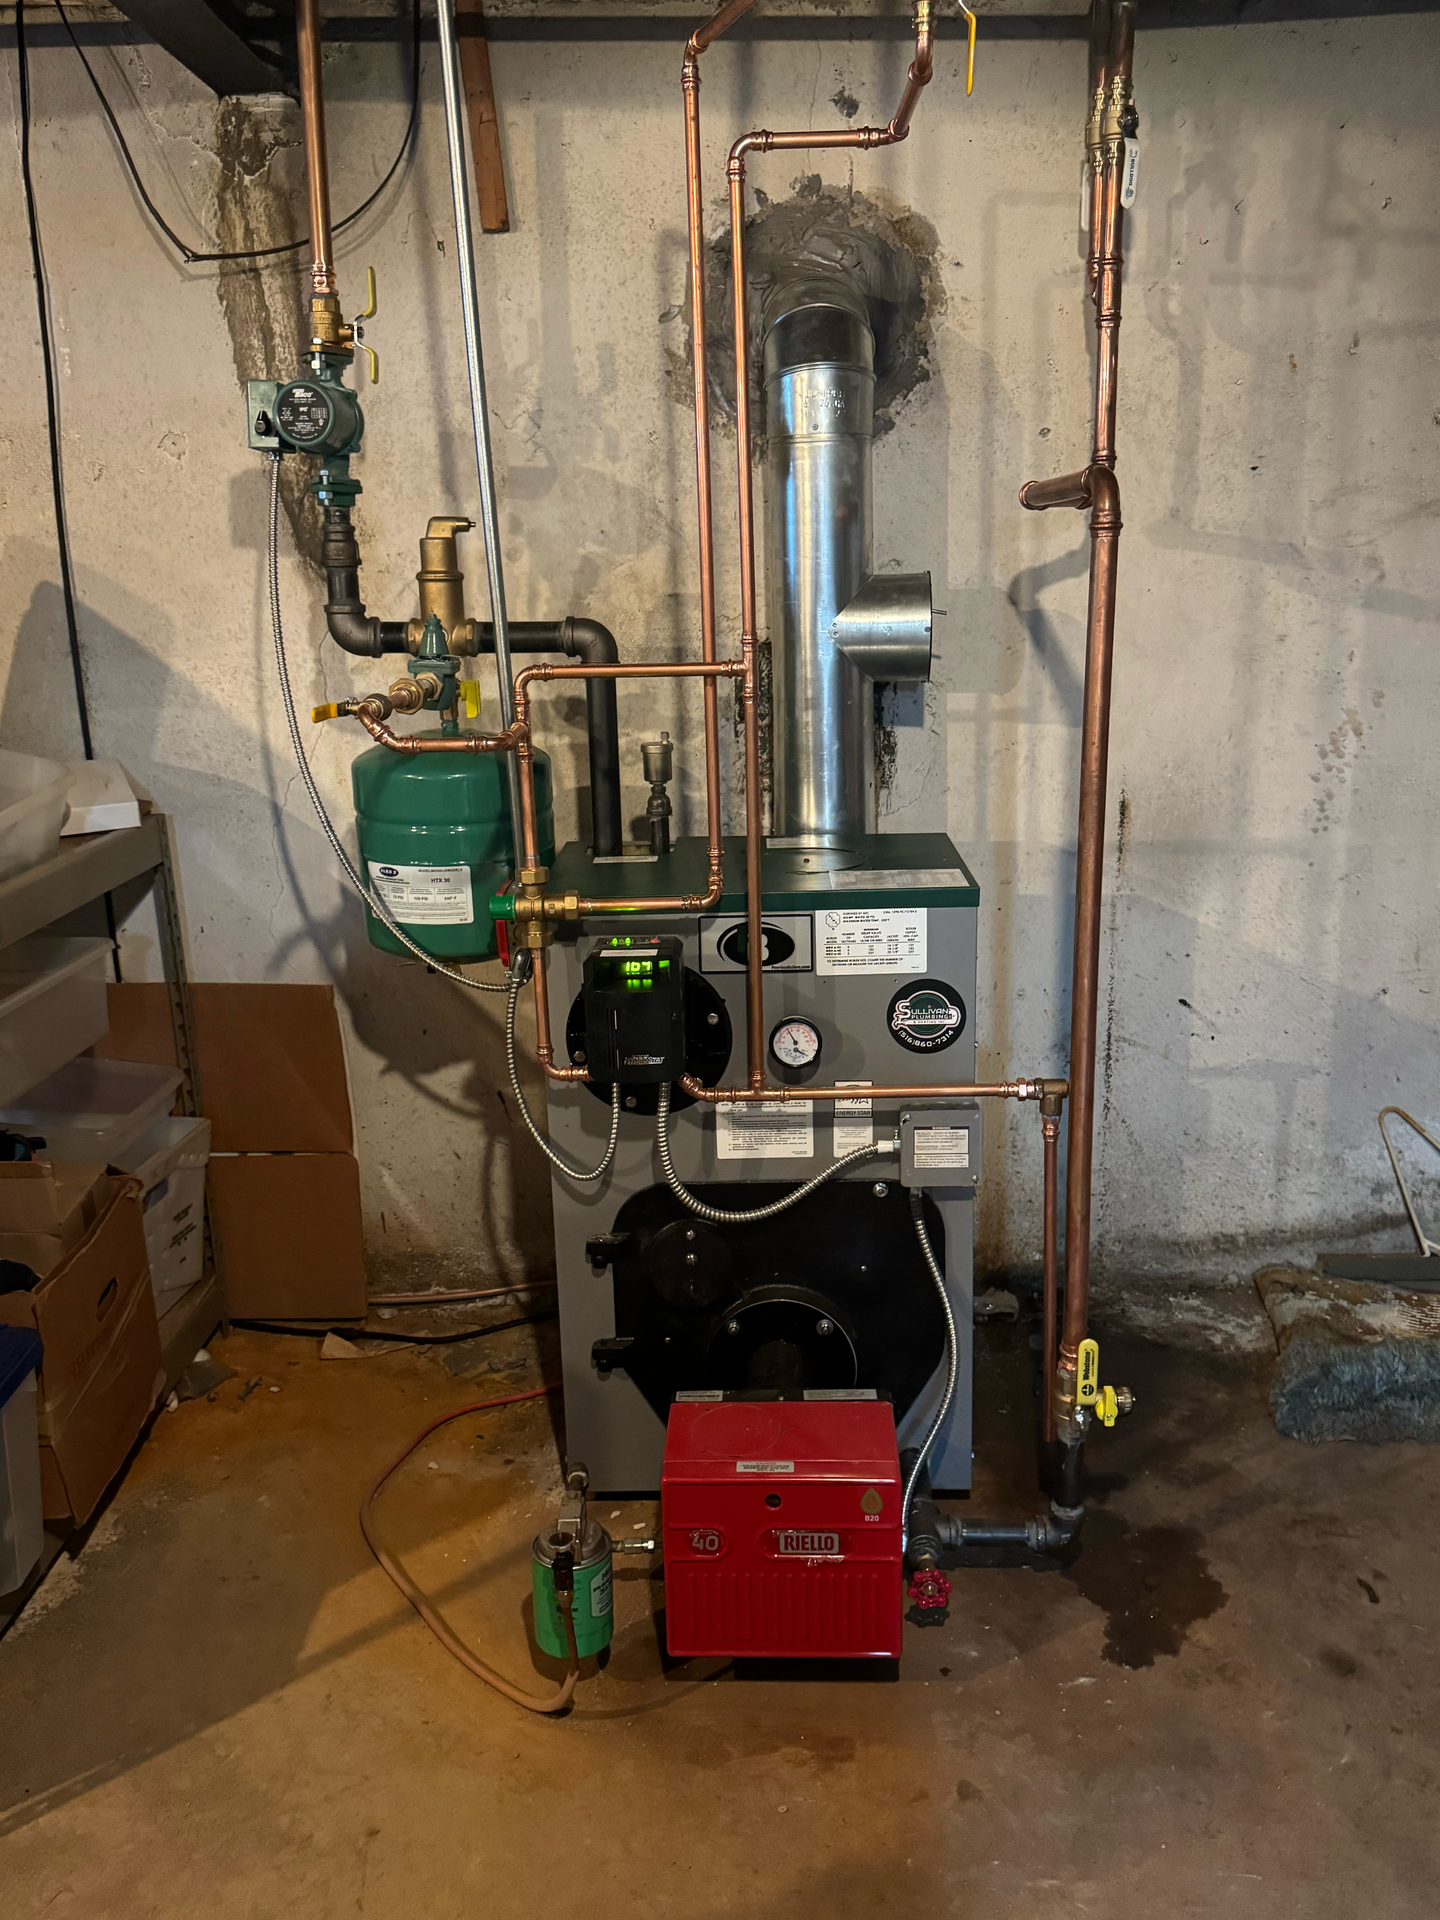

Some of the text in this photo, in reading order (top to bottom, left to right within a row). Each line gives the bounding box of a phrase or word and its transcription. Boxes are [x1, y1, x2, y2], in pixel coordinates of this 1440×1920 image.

[1128, 158, 1136, 187] BULLDOG
[898, 1002, 950, 1018] SULLIVAN
[898, 1030, 954, 1048] (516)860-7314
[864, 1514, 880, 1522] B20
[691, 1533, 720, 1551] 40
[784, 1535, 835, 1552] RIELLO
